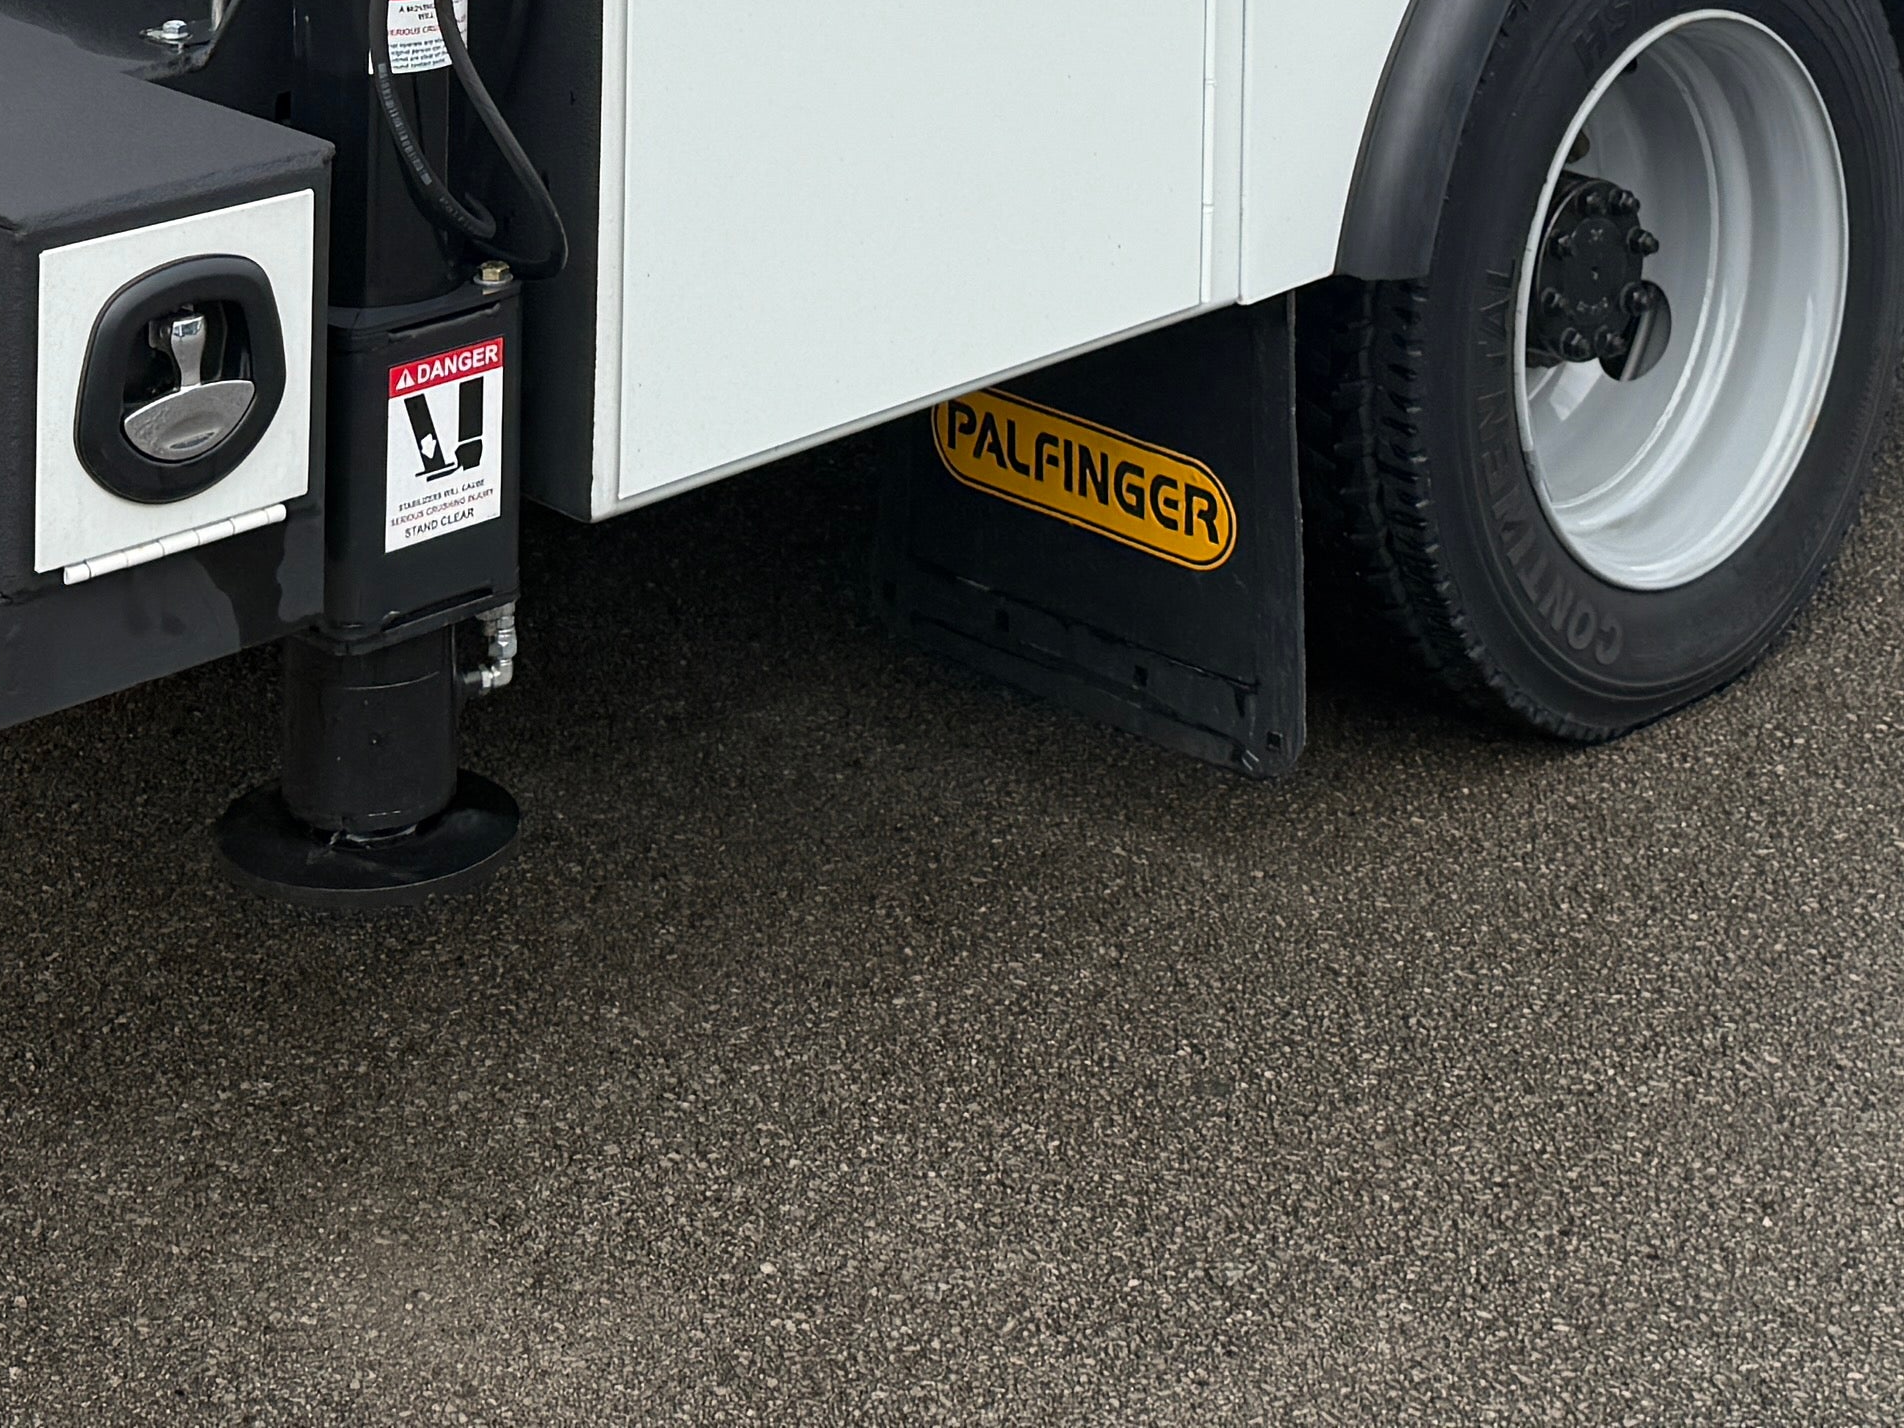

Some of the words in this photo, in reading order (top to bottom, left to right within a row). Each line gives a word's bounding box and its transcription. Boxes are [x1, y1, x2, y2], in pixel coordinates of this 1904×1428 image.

[417, 344, 498, 384] DANGER
[946, 399, 1220, 544] PALFINGER
[1475, 258, 1624, 665] CONTINENTAL
[391, 509, 424, 527] SERIOUS
[426, 497, 466, 517] CRUSHING
[405, 519, 438, 538] STAND
[441, 508, 474, 527] CLEAR
